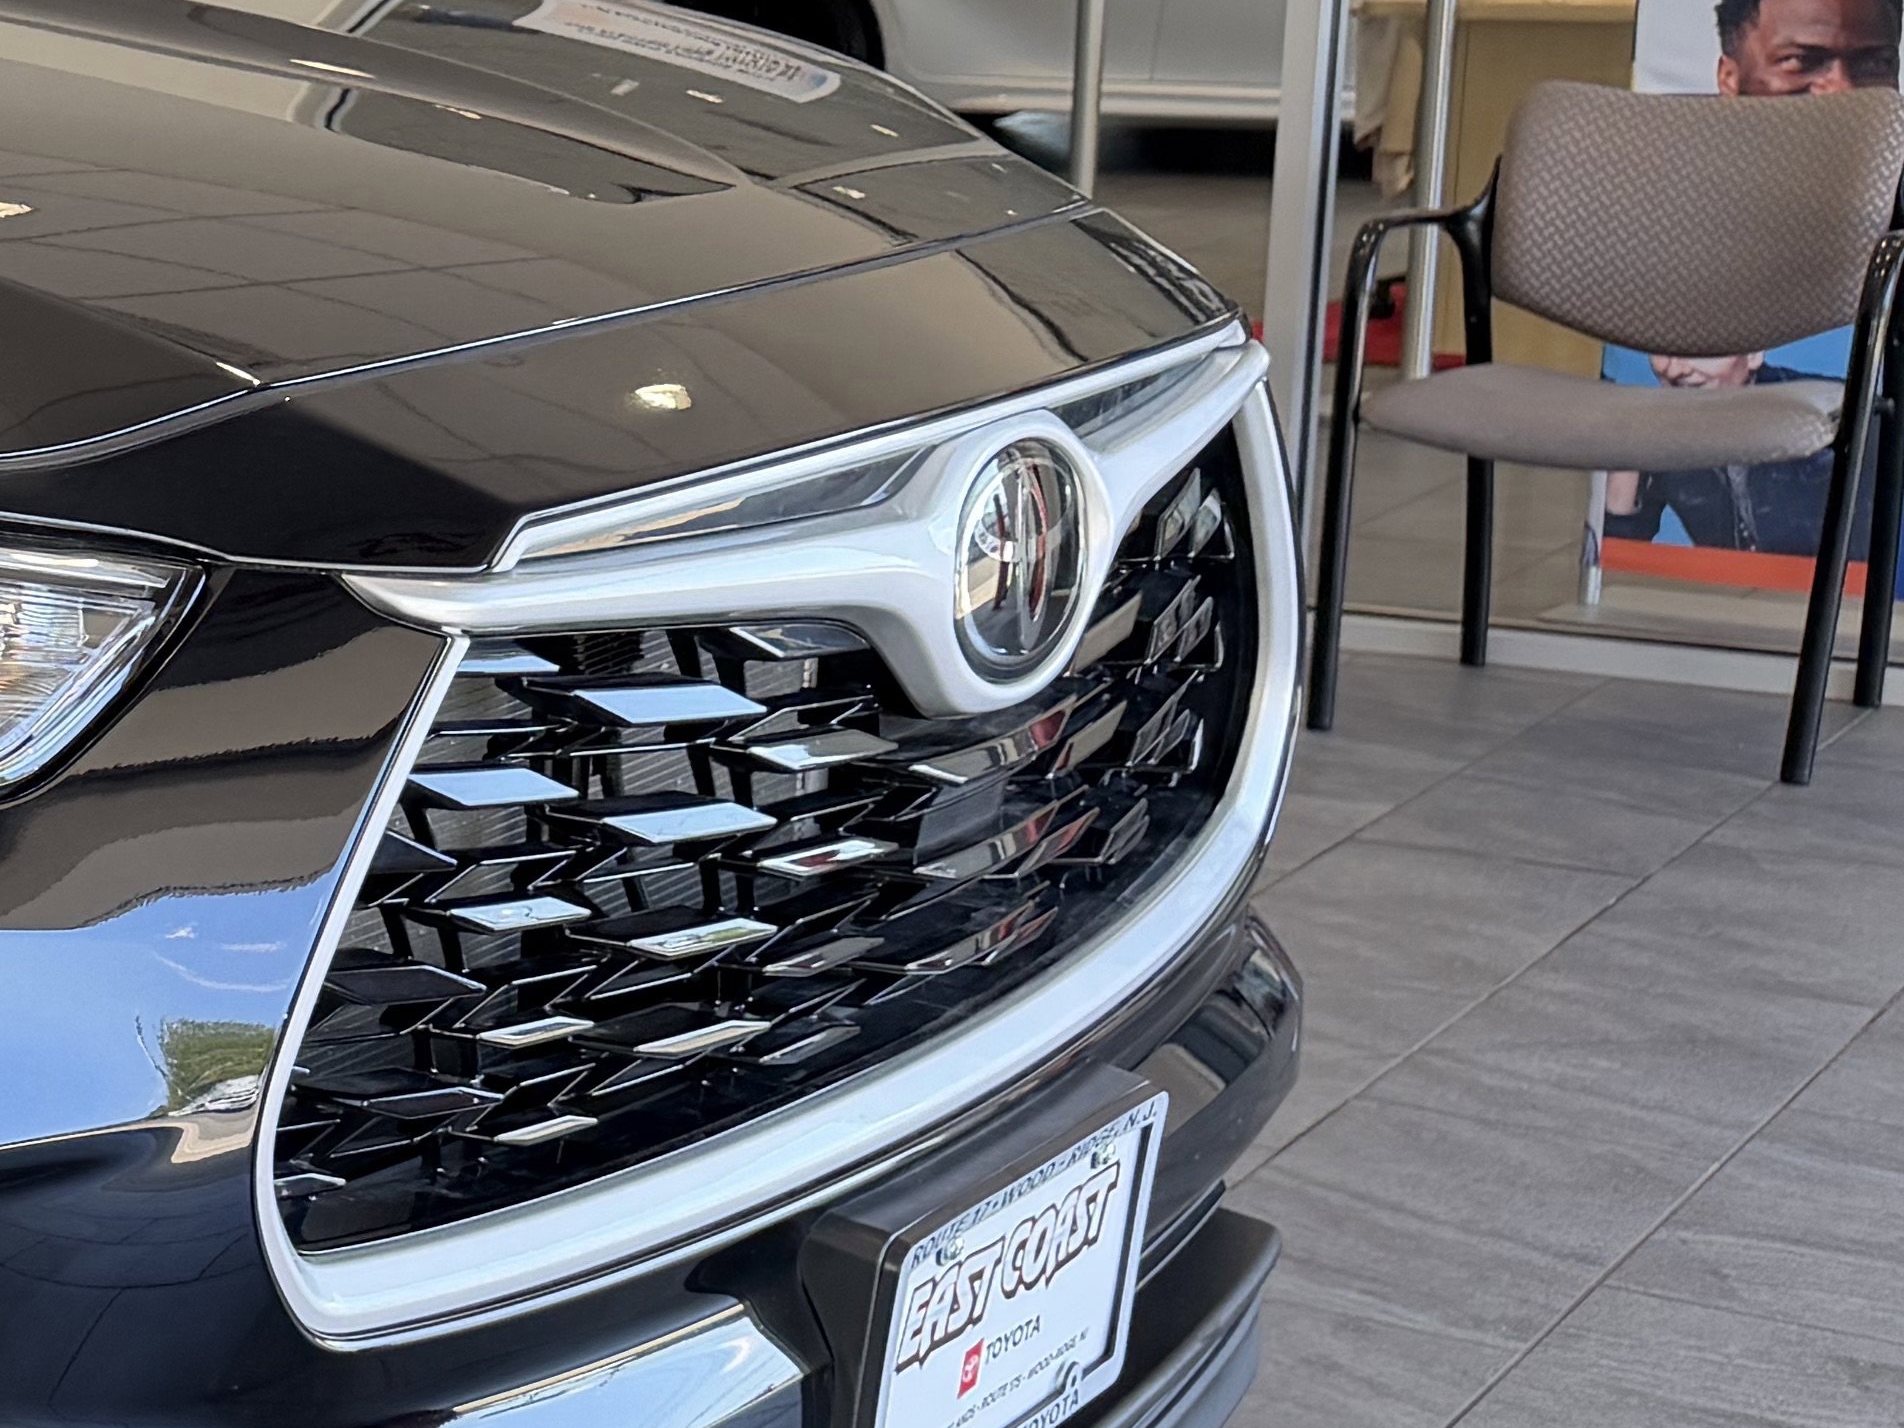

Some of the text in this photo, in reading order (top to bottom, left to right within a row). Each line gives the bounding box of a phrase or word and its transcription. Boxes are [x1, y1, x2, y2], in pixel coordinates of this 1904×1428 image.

[894, 1159, 1121, 1375] EAST COAST
[985, 1314, 1041, 1365] TOYOTA
